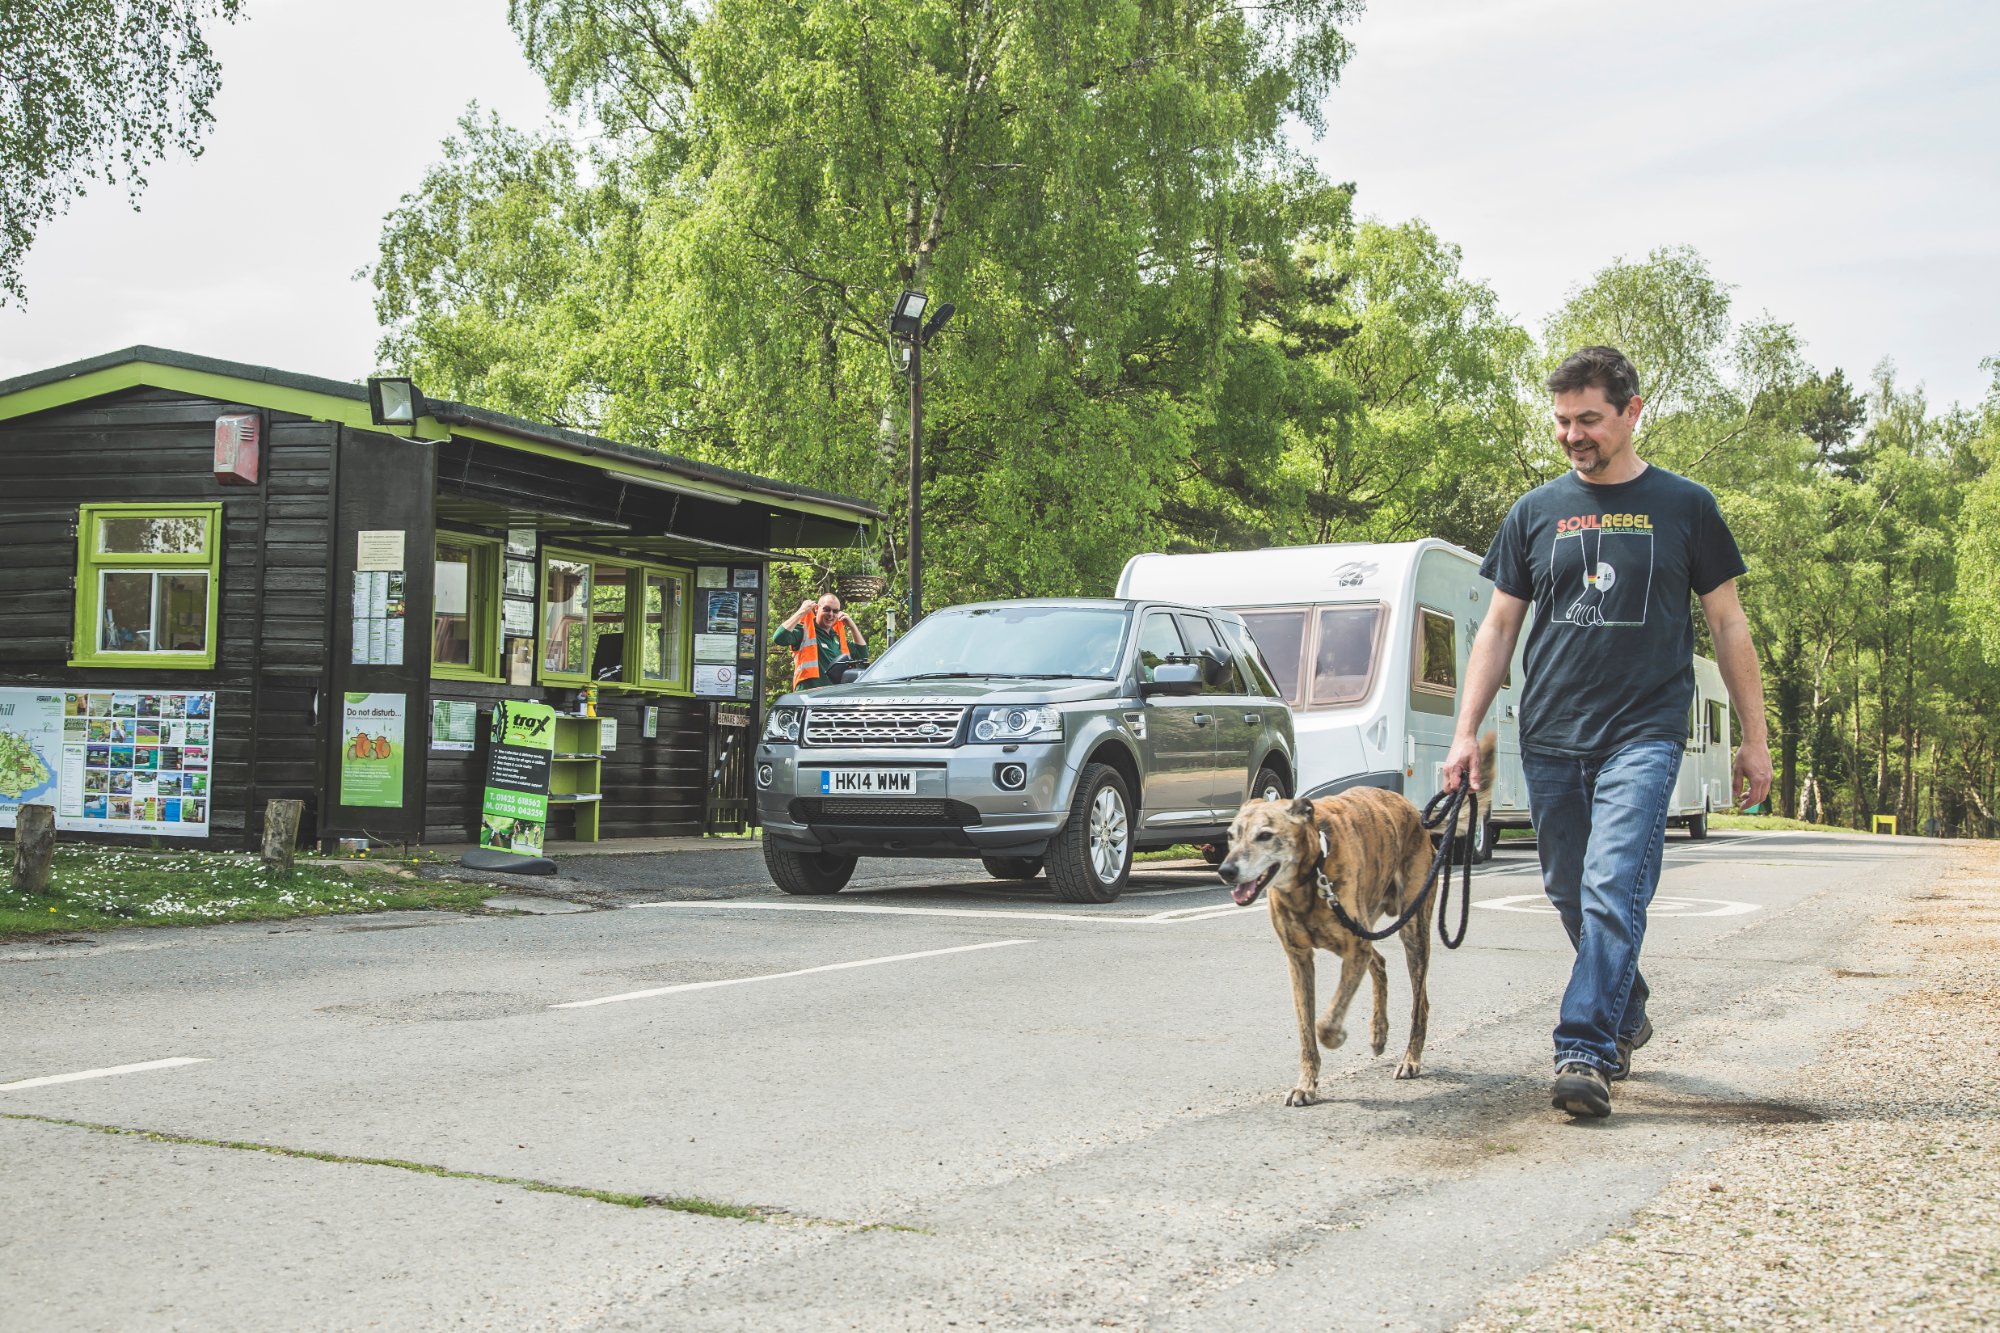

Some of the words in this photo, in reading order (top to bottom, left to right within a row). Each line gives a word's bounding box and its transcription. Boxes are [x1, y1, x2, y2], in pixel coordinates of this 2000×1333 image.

[346, 708, 356, 716] Do
[358, 708, 370, 716] not
[372, 708, 402, 717] disturb...
[513, 713, 551, 737] trax
[836, 773, 872, 790] HK14
[878, 773, 910, 790] WMW
[496, 794, 515, 803] 01425
[495, 803, 515, 813] 07850
